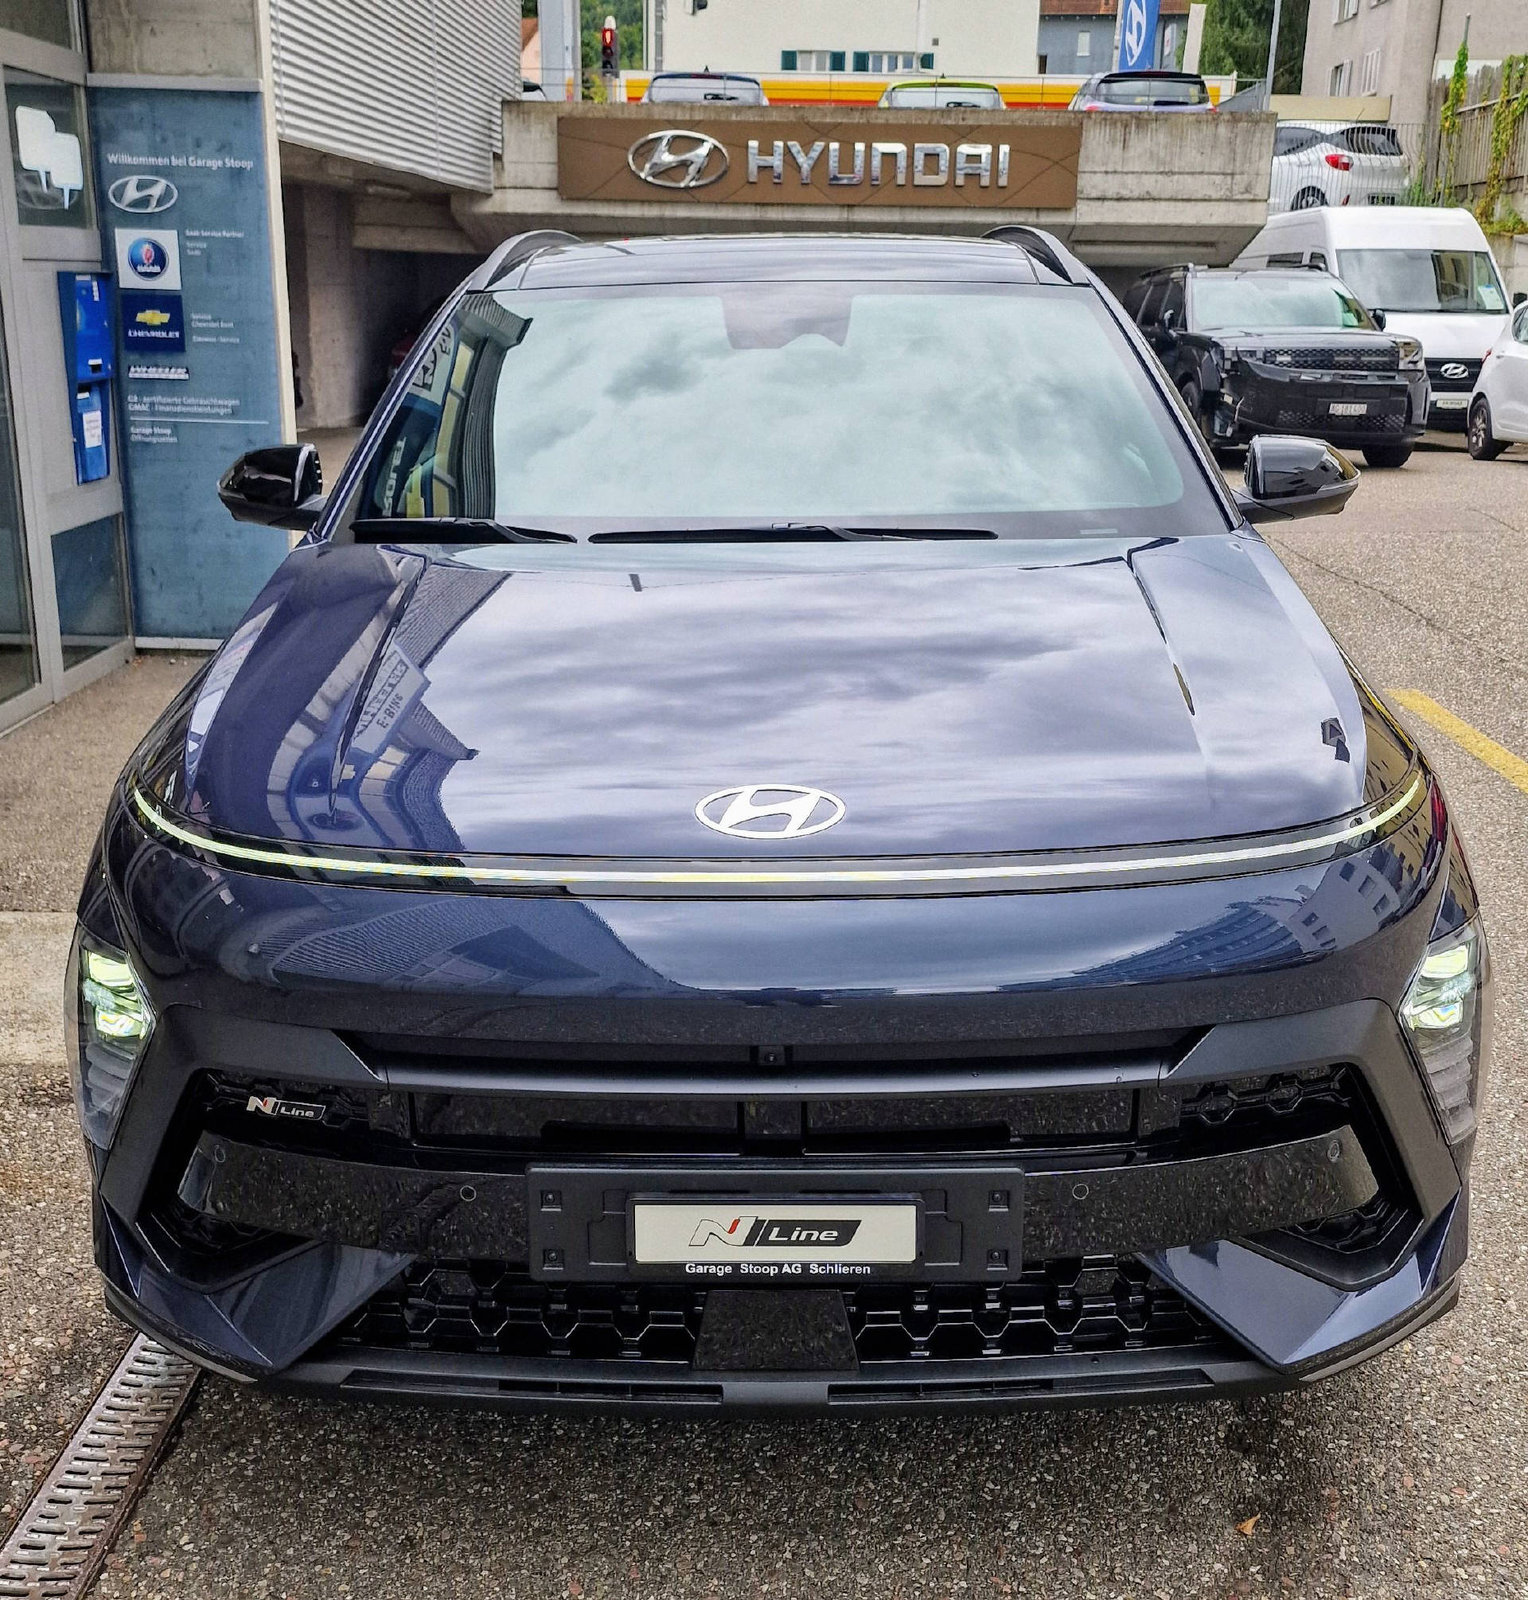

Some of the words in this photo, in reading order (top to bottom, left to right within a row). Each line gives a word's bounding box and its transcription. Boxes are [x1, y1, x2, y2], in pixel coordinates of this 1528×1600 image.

[107, 153, 170, 166] Willkommen
[171, 155, 187, 167] bei
[188, 156, 223, 170] Garage
[225, 157, 254, 171] Stoop
[746, 139, 1011, 188] HYUNDAI
[280, 1106, 315, 1118] Line
[689, 1216, 758, 1246] N
[768, 1227, 839, 1241] Line
[685, 1263, 733, 1276] Garage
[739, 1263, 779, 1276] Stoop
[781, 1263, 802, 1275] AG
[809, 1263, 871, 1275] Schlieren
